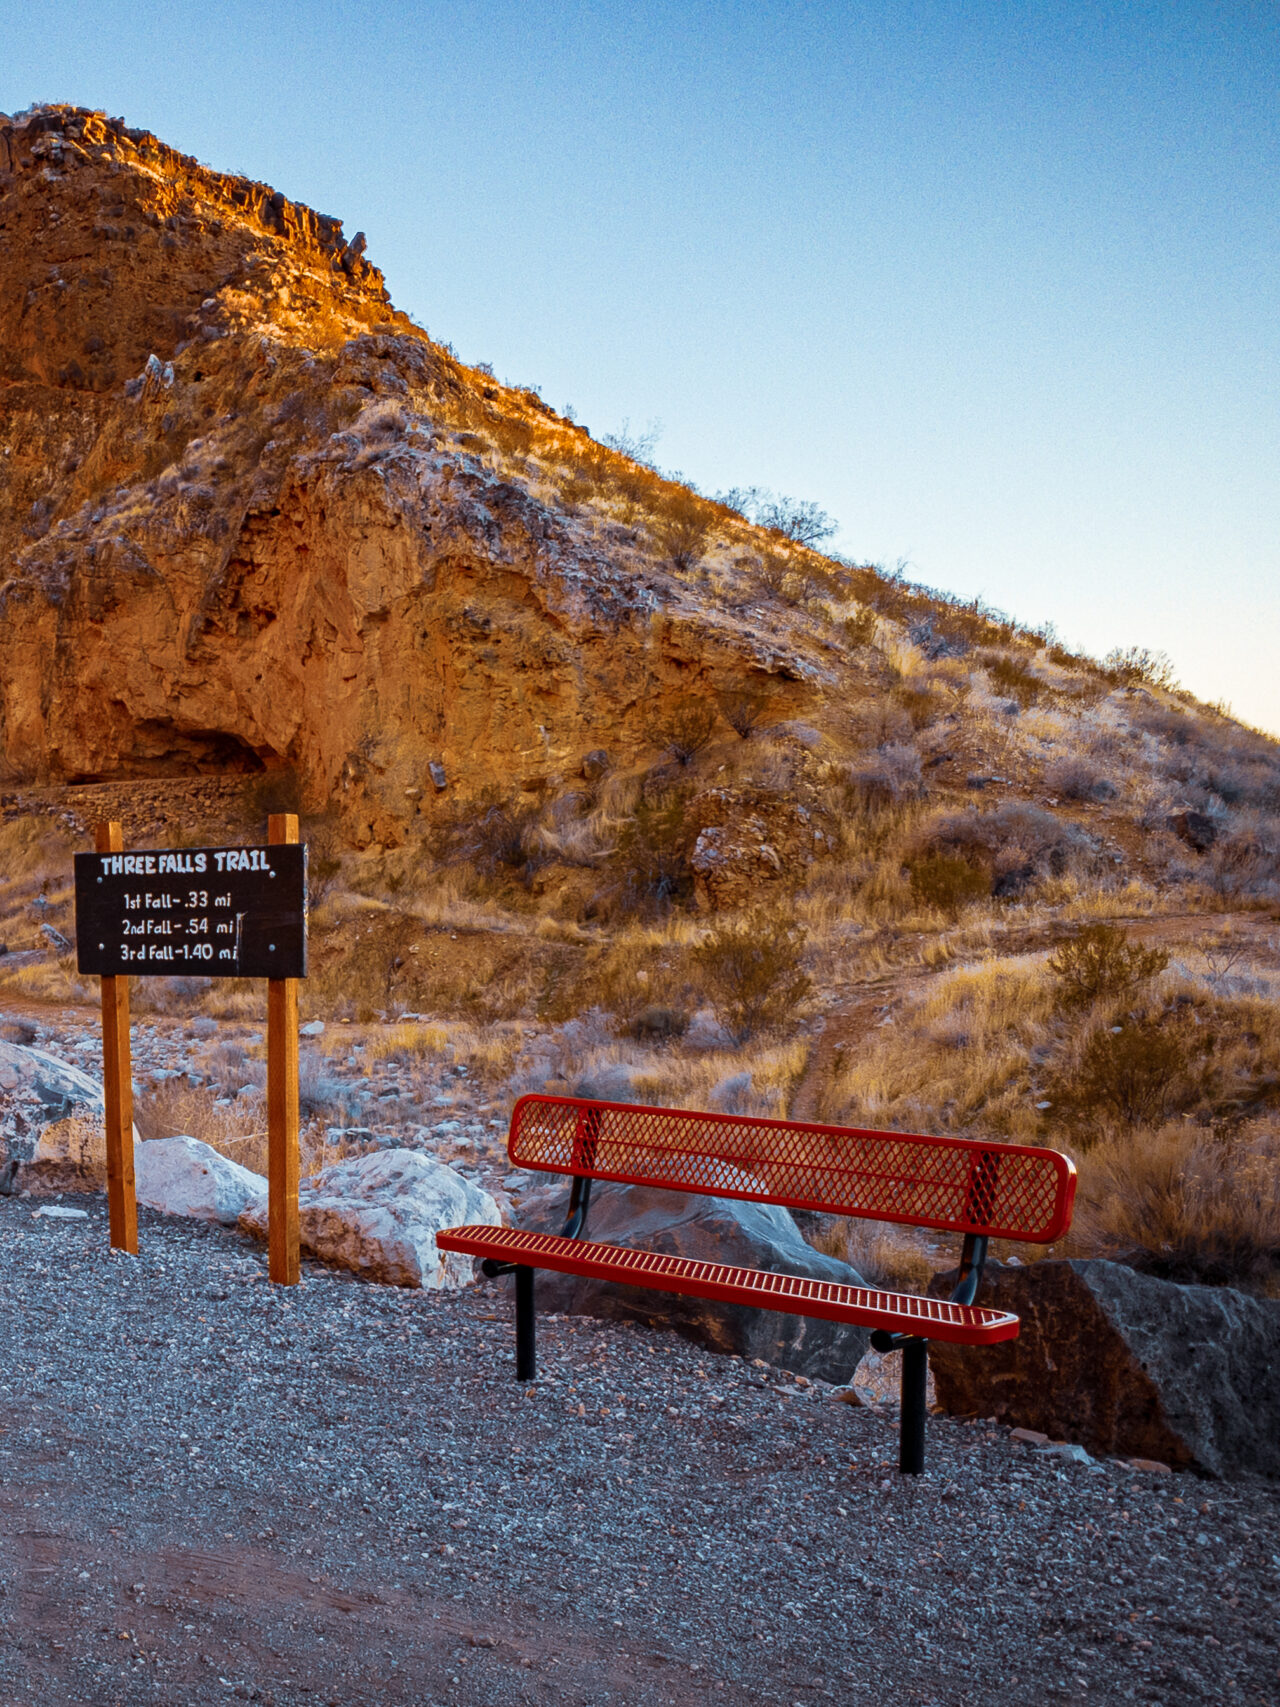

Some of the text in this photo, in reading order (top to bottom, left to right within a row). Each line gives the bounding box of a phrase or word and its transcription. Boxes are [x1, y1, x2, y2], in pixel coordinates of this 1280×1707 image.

[100, 850, 270, 875] THREE FALLS TRAIL
[124, 894, 141, 909] 1st
[184, 892, 208, 908] .33
[214, 892, 231, 907] mi
[122, 920, 144, 935] 2nd
[185, 918, 208, 934] .54
[216, 920, 233, 934] mi
[120, 944, 145, 960] 3rd
[219, 946, 238, 960] mi
